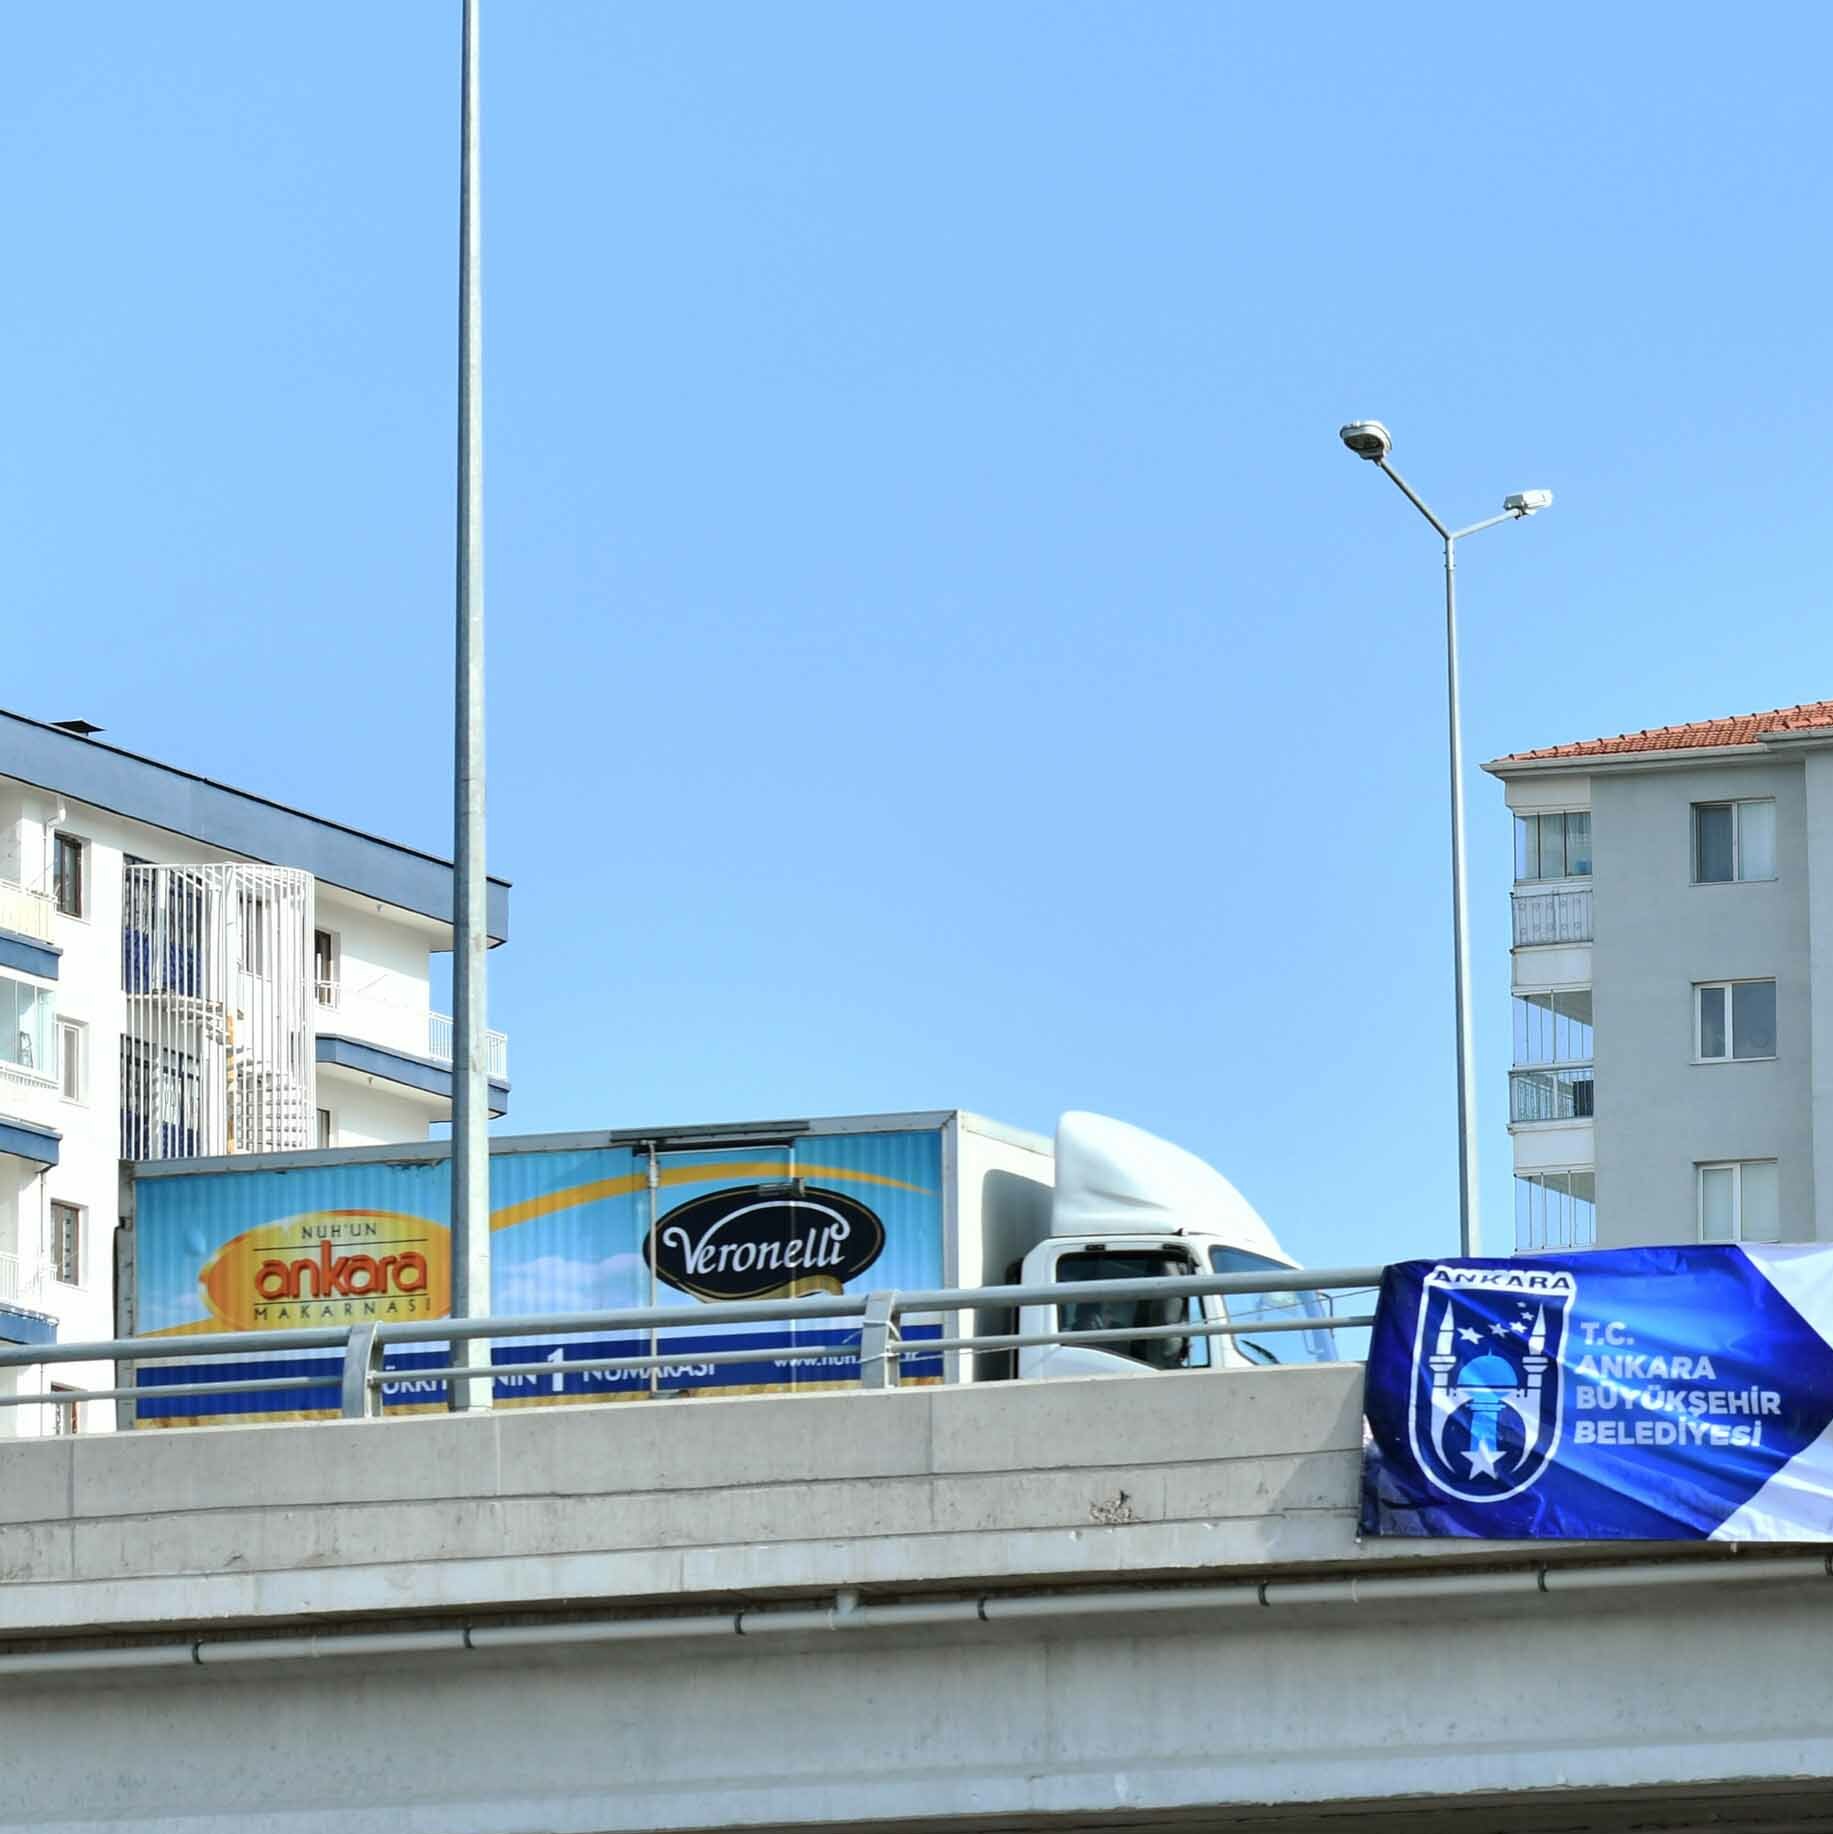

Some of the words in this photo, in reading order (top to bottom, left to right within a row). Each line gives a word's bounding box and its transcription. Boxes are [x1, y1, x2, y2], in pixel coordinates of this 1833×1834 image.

[663, 1200, 850, 1275] Veronelli
[255, 1239, 428, 1300] ankara
[1434, 1269, 1572, 1290] ANKARA
[254, 1298, 431, 1320] MAKARNASI
[1580, 1322, 1635, 1346] T.C.
[1574, 1355, 1717, 1380] ANKARA
[1575, 1384, 1782, 1417] BÜYÜKŞEHİR
[1573, 1415, 1763, 1448] BELEDİYESİ
